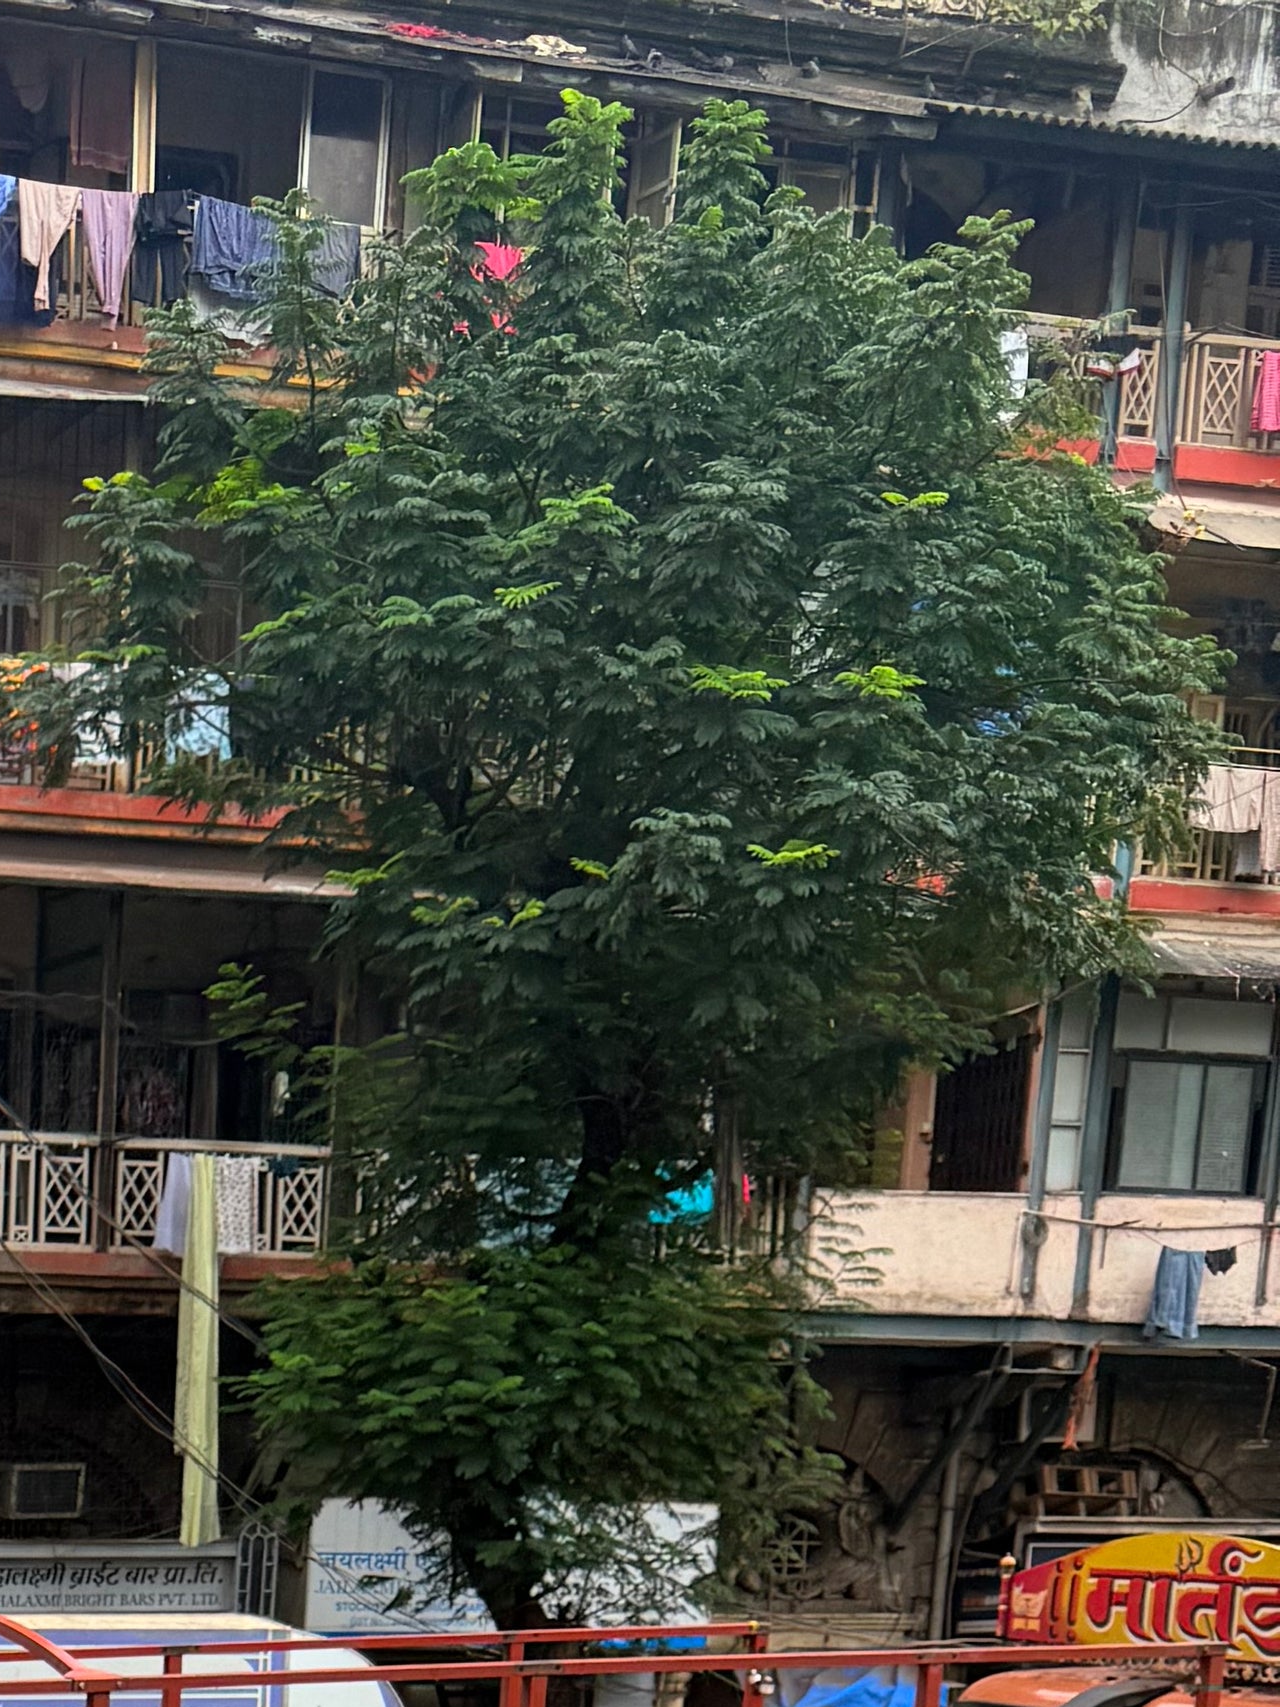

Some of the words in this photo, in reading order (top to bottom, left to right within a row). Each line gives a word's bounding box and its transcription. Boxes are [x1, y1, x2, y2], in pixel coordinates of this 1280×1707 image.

[68, 1562, 119, 1589] ब्राईट
[125, 1567, 159, 1585] बार
[64, 1593, 118, 1607] BRIGHT
[120, 1592, 155, 1606] BARS
